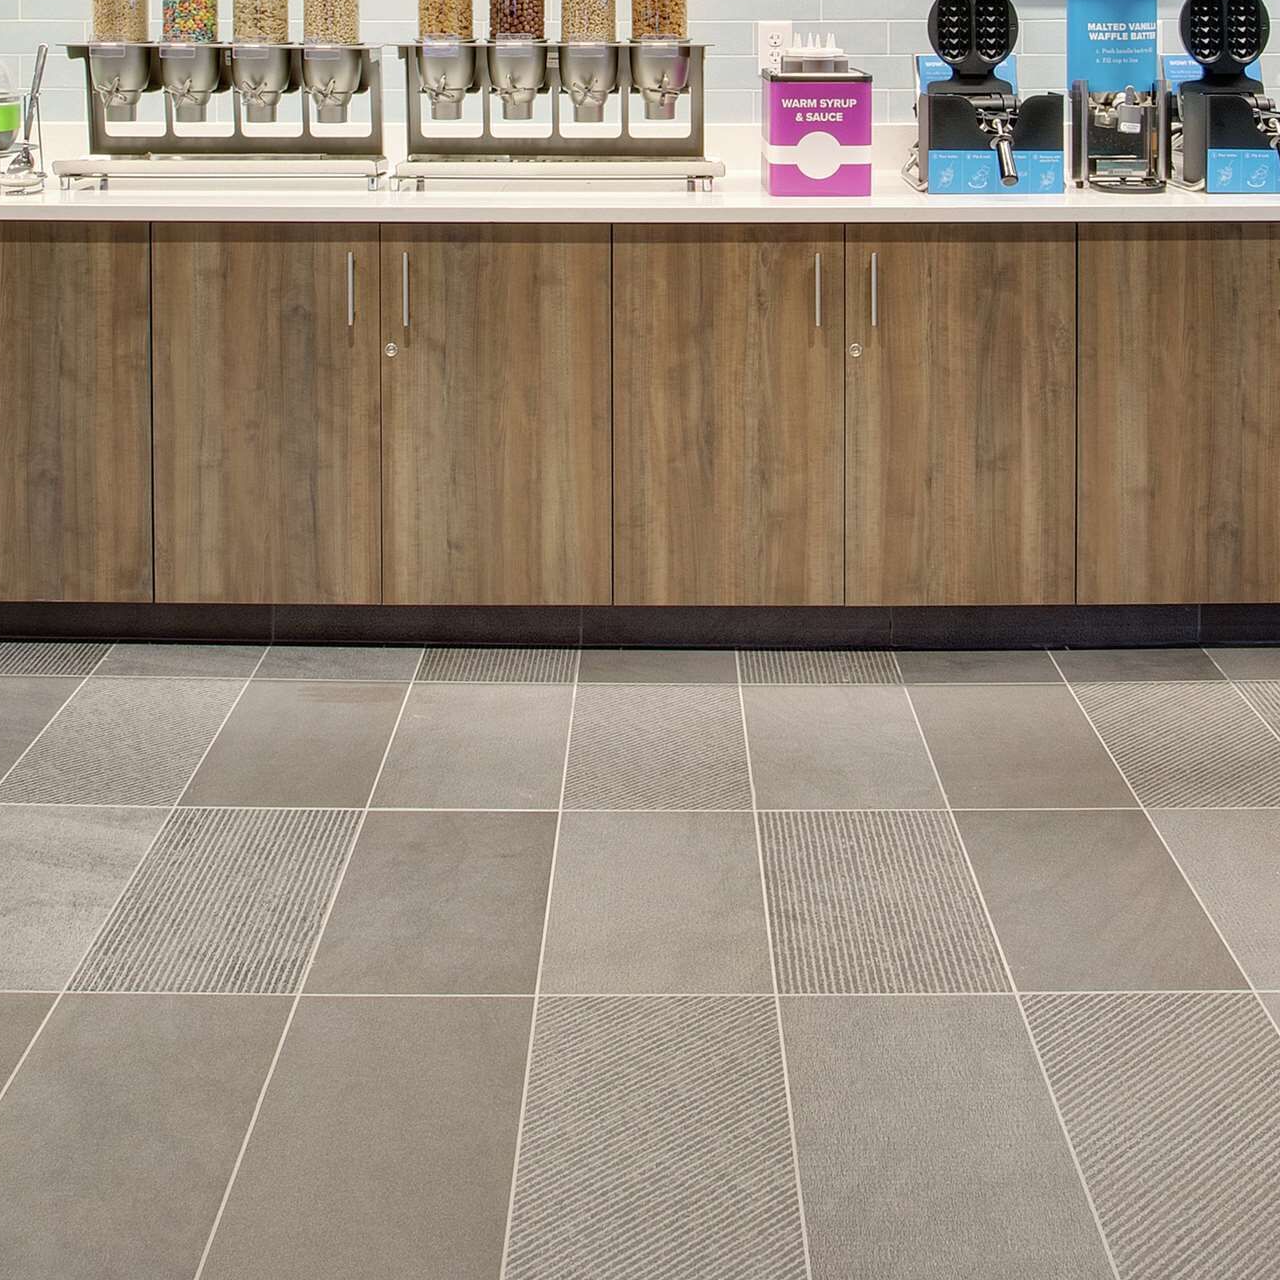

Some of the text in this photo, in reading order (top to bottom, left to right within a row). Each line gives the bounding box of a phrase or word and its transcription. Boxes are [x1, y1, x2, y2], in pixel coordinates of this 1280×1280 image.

[1088, 22, 1156, 31] MALTED VANILL
[1089, 32, 1128, 40] WAFFLE
[781, 98, 857, 108] WARM SYRUP
[795, 112, 844, 122] & SAUCE
